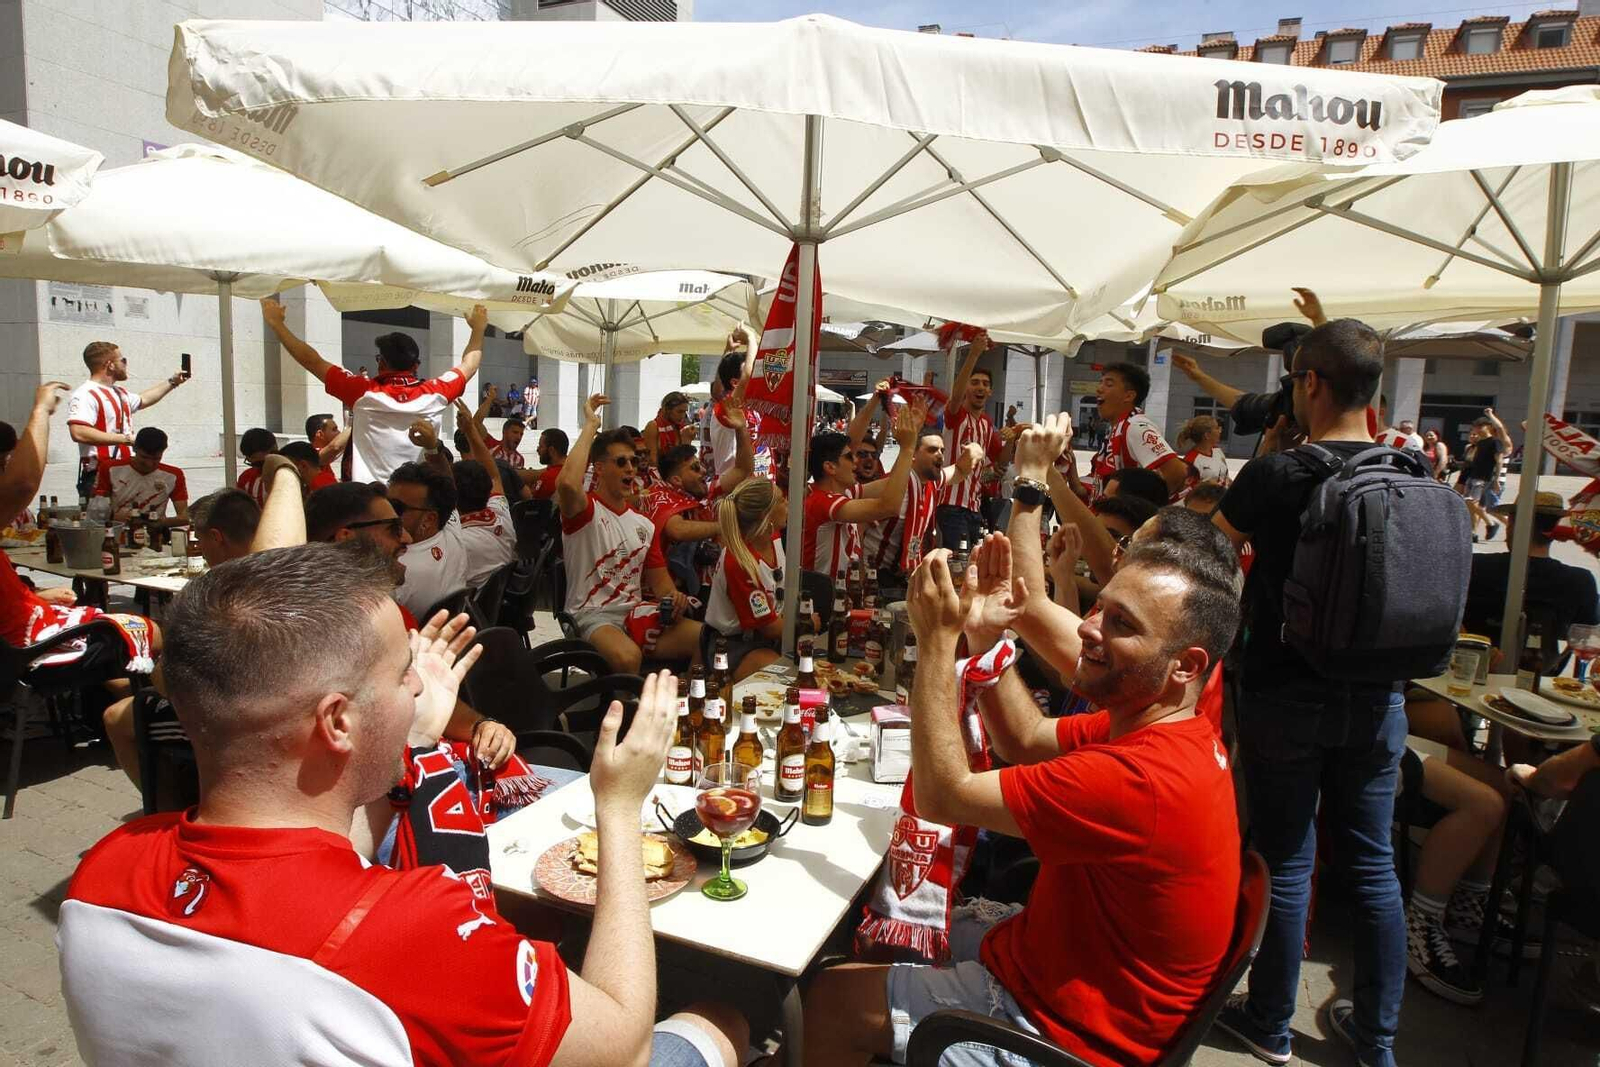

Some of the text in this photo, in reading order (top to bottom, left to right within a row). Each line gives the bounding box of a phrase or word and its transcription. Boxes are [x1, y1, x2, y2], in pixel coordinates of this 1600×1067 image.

[1214, 79, 1382, 131] Mahou
[1214, 132, 1377, 158] DESDE 1890
[516, 276, 556, 296] Maho
[668, 758, 691, 767] Mahou
